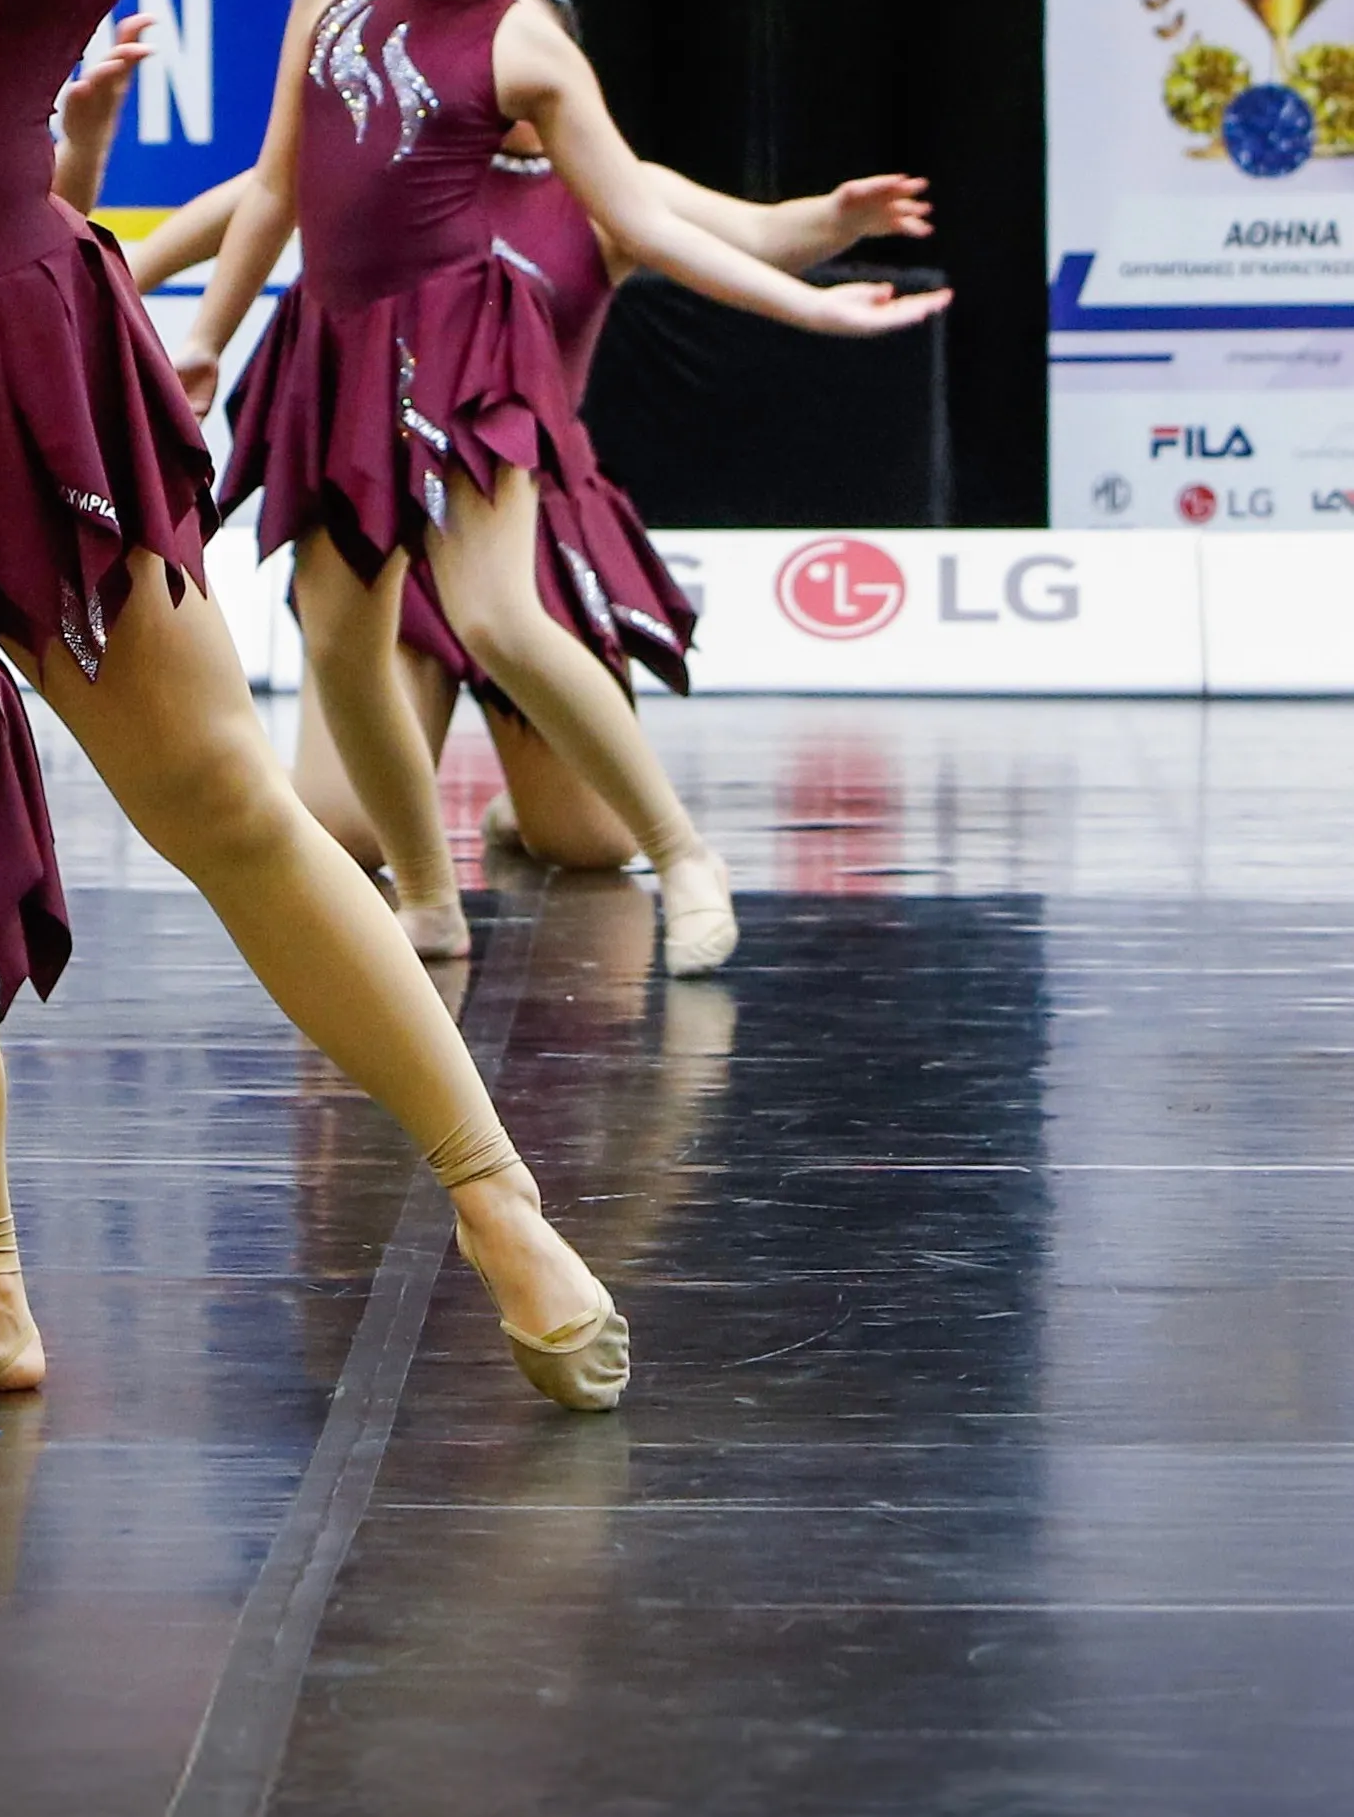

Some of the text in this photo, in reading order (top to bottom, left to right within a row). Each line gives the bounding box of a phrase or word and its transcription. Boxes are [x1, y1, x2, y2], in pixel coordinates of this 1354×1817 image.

[1224, 220, 1340, 248] ΑΘΗΝΑ
[1150, 424, 1255, 460] FILA
[1227, 488, 1274, 518] LG
[939, 555, 1080, 623] LG
